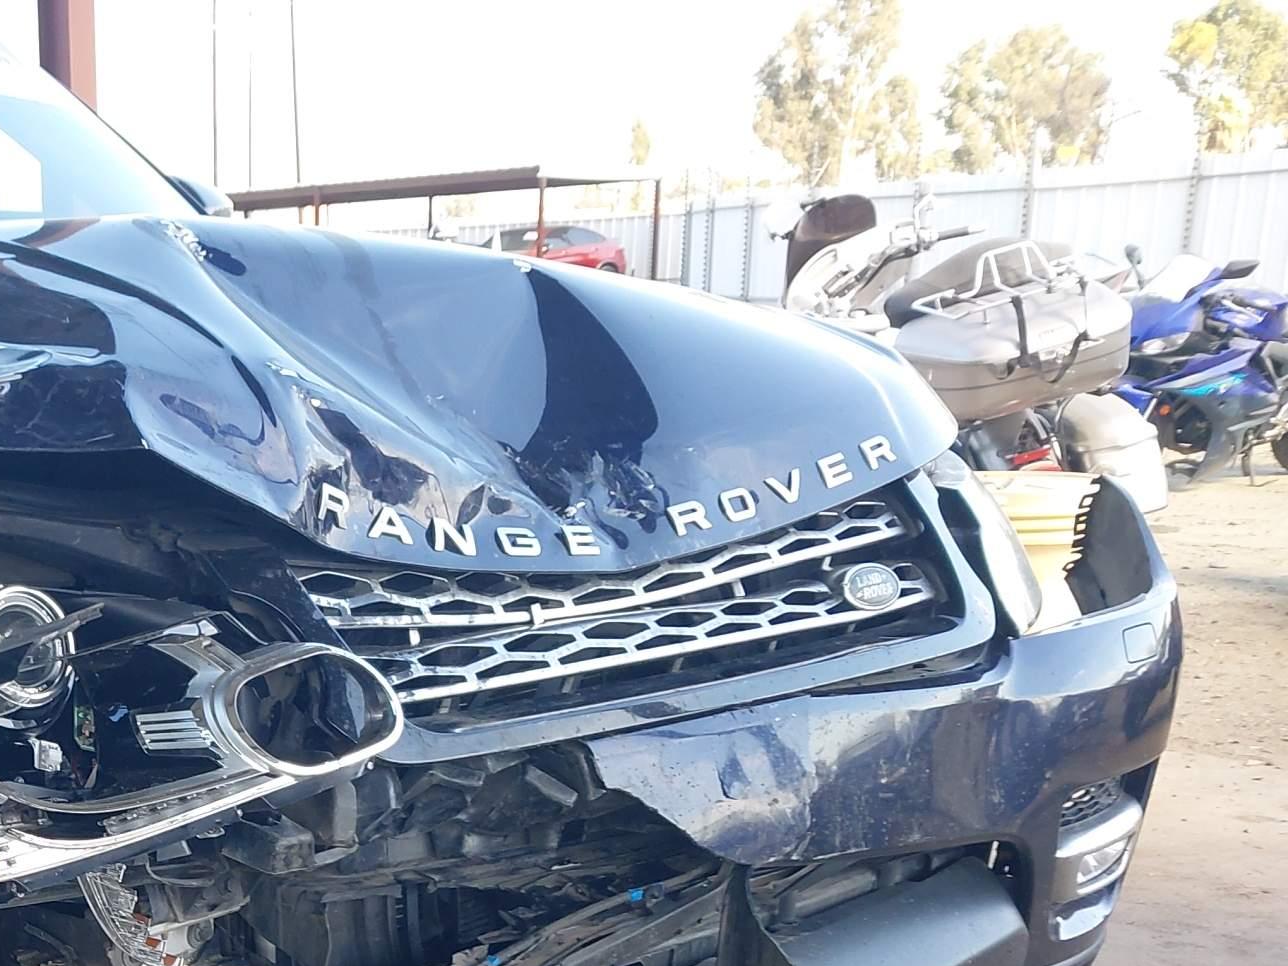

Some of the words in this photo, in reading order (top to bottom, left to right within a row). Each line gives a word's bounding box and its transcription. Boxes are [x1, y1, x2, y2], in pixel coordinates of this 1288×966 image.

[318, 483, 602, 556] RANGE
[667, 434, 898, 537] ROVER
[853, 573, 882, 588] LAND
[863, 582, 894, 600] ROVER
